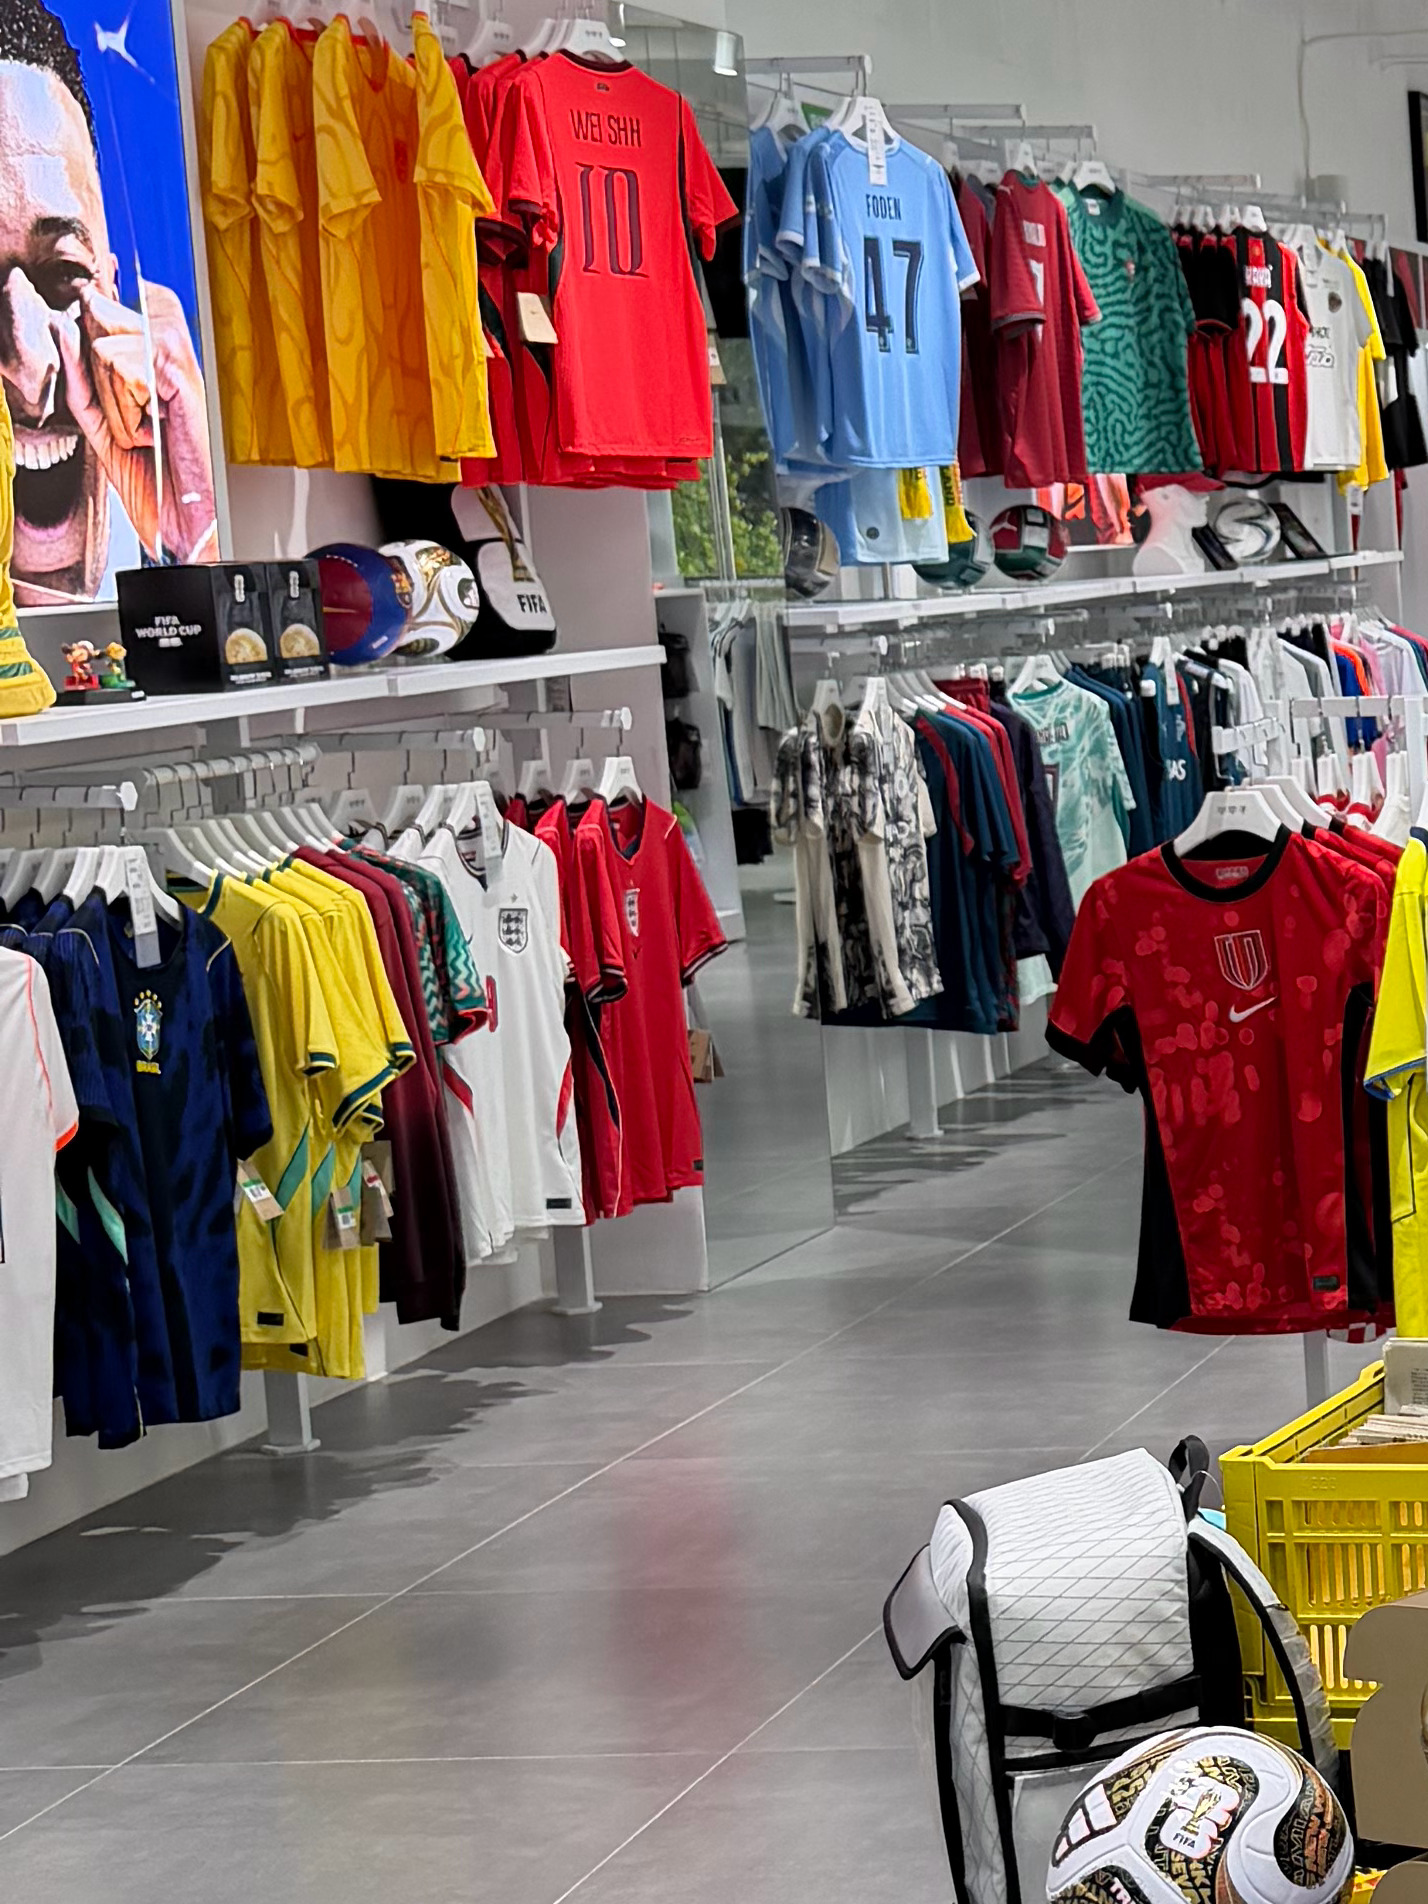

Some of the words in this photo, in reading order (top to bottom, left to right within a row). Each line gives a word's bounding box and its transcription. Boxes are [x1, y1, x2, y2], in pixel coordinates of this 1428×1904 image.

[866, 194, 902, 221] FODEN
[574, 160, 650, 279] 10
[863, 235, 923, 354] 47
[516, 593, 547, 615] FIFA
[135, 625, 177, 639] WORLD
[178, 624, 203, 637] CUP
[154, 616, 181, 627] FIFA
[1172, 1831, 1197, 1850] FIFA
